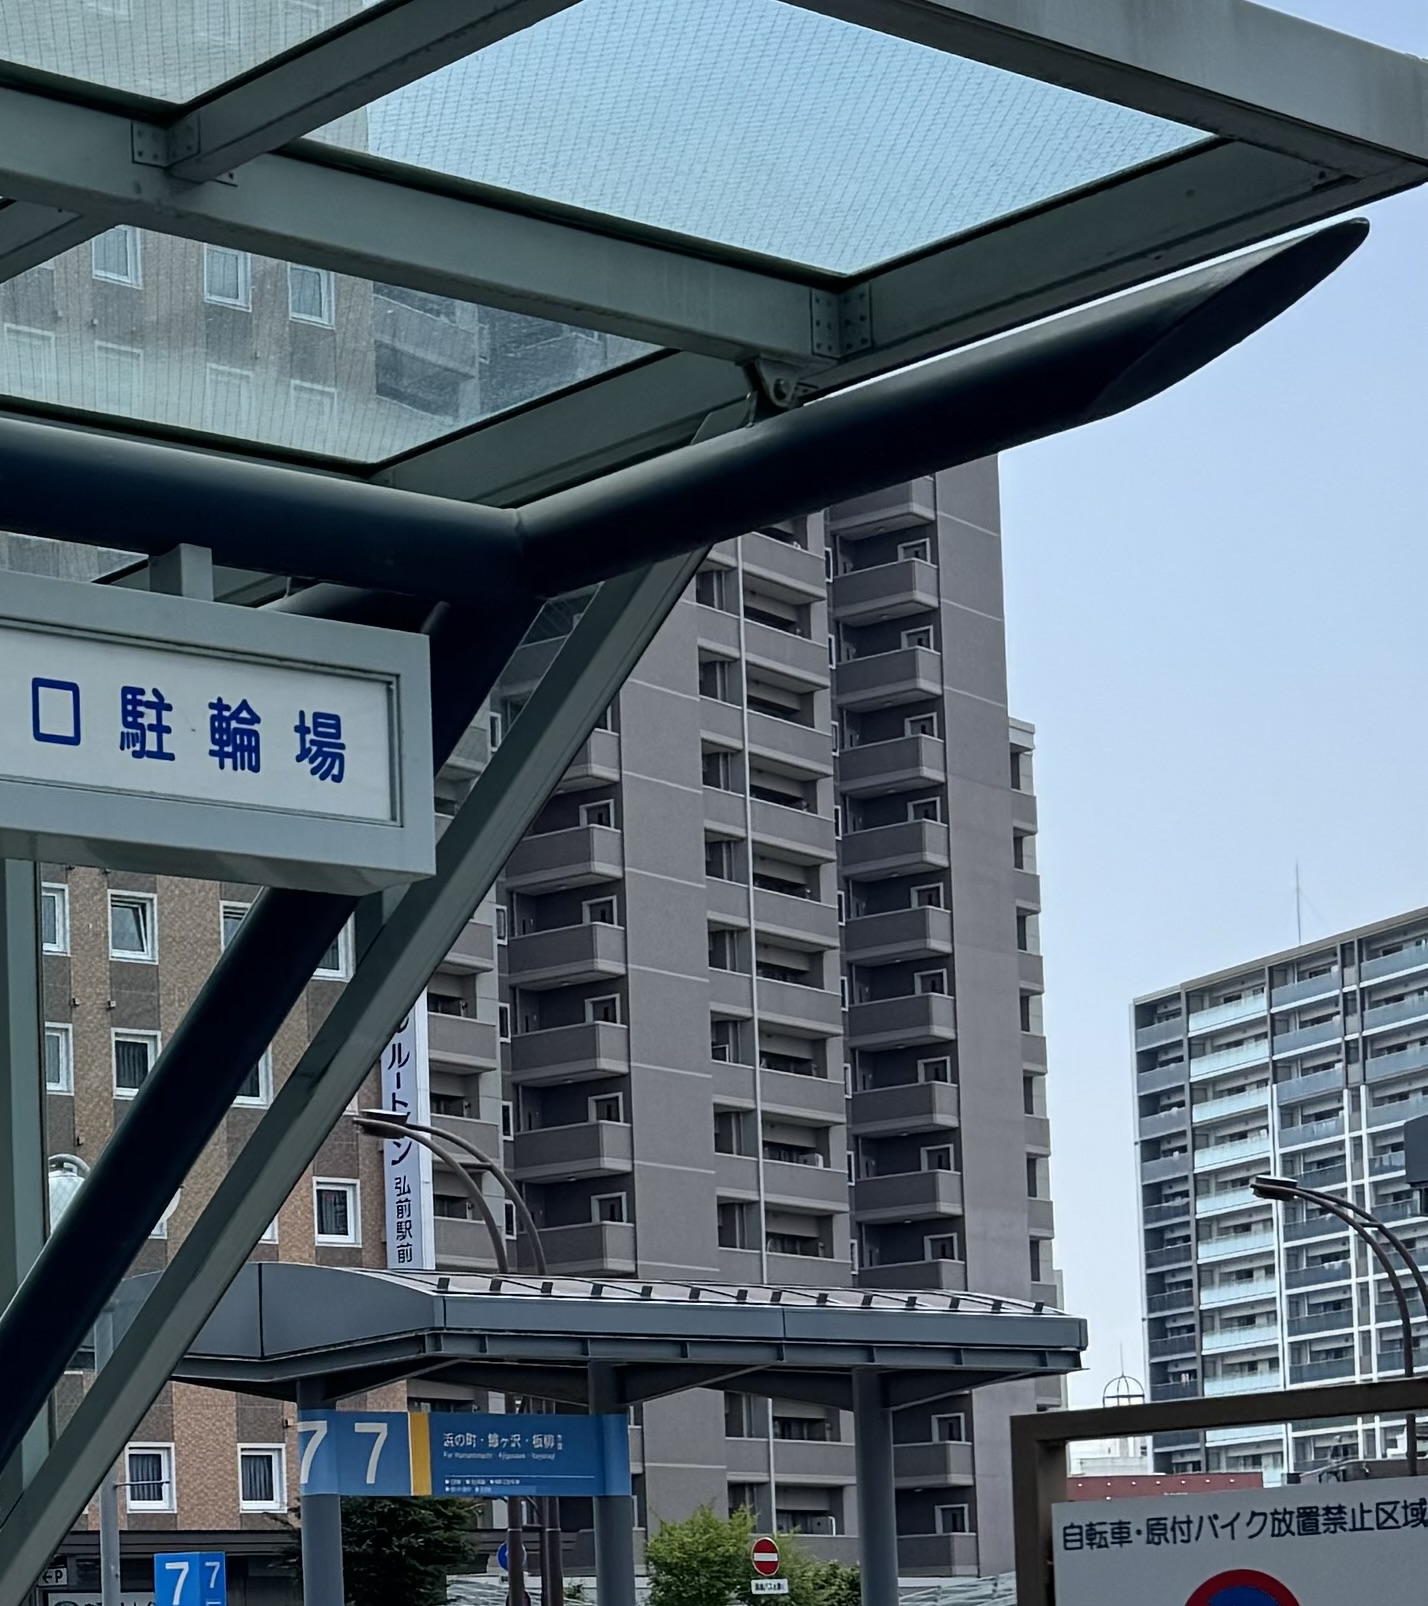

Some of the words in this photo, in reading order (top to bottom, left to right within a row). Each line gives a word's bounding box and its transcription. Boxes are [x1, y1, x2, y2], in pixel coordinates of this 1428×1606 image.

[394, 1176, 413, 1264] 弘前駅前
[299, 1420, 328, 1484] 7
[354, 1422, 388, 1484] 7
[1062, 1498, 1428, 1551] 自転車・原付バイク放置禁止区域
[55, 1570, 63, 1583] P
[165, 1562, 189, 1606] 7
[205, 1562, 220, 1588] 7
